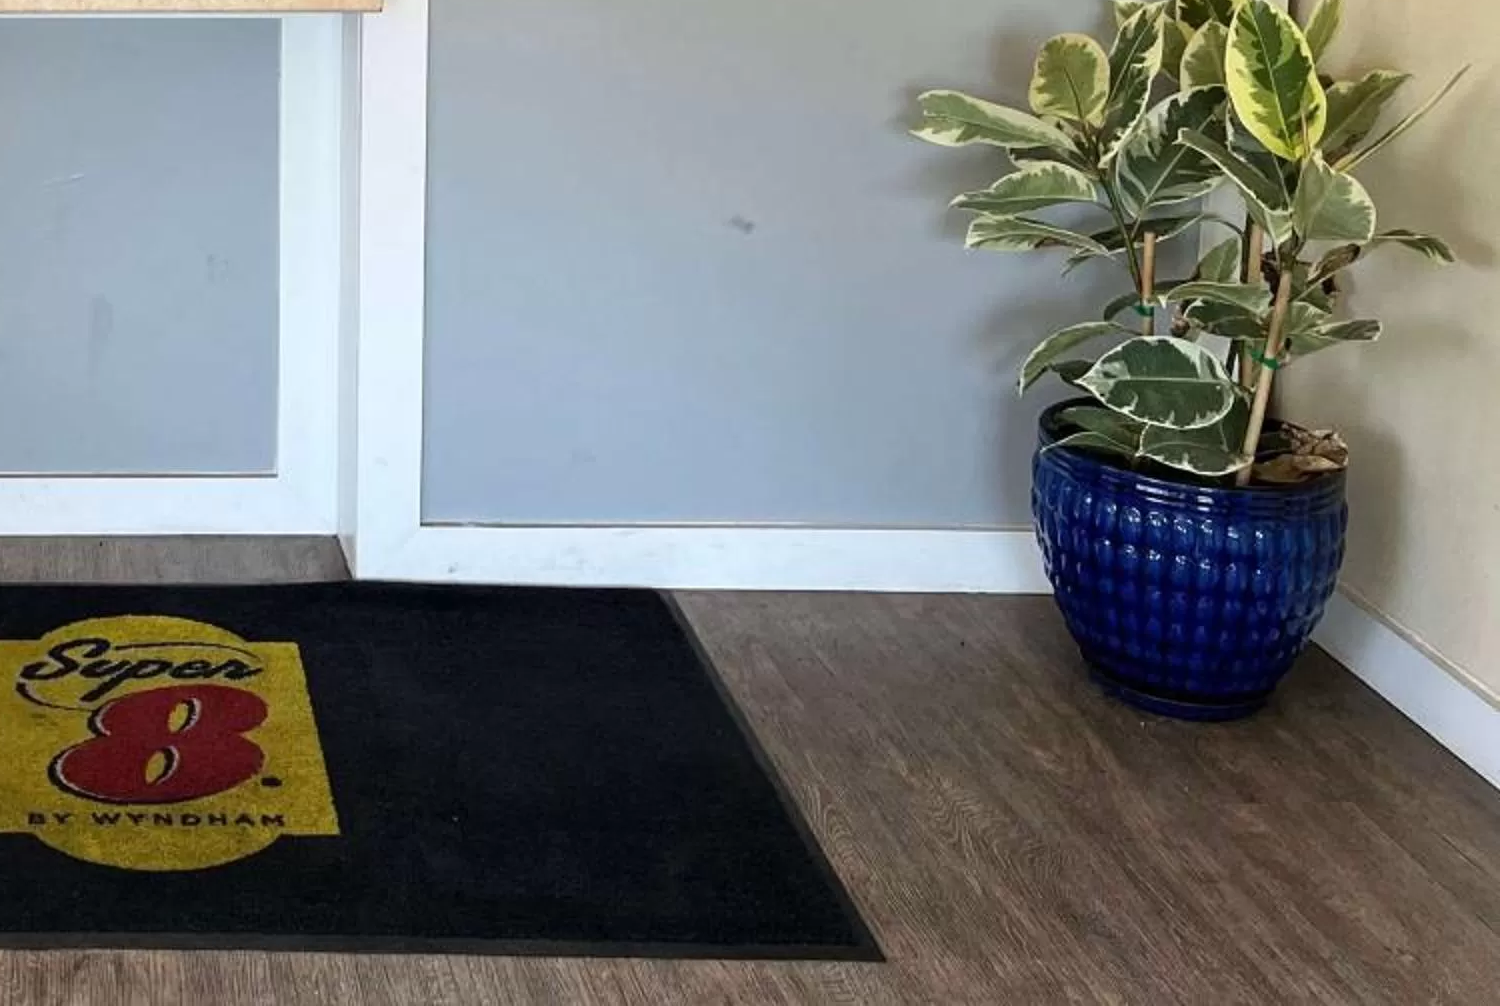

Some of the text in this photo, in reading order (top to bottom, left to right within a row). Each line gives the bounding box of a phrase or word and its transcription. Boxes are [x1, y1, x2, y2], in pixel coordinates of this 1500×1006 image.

[19, 638, 264, 704] Super
[48, 684, 268, 806] 8
[28, 812, 286, 828] BY WYNDHAM
